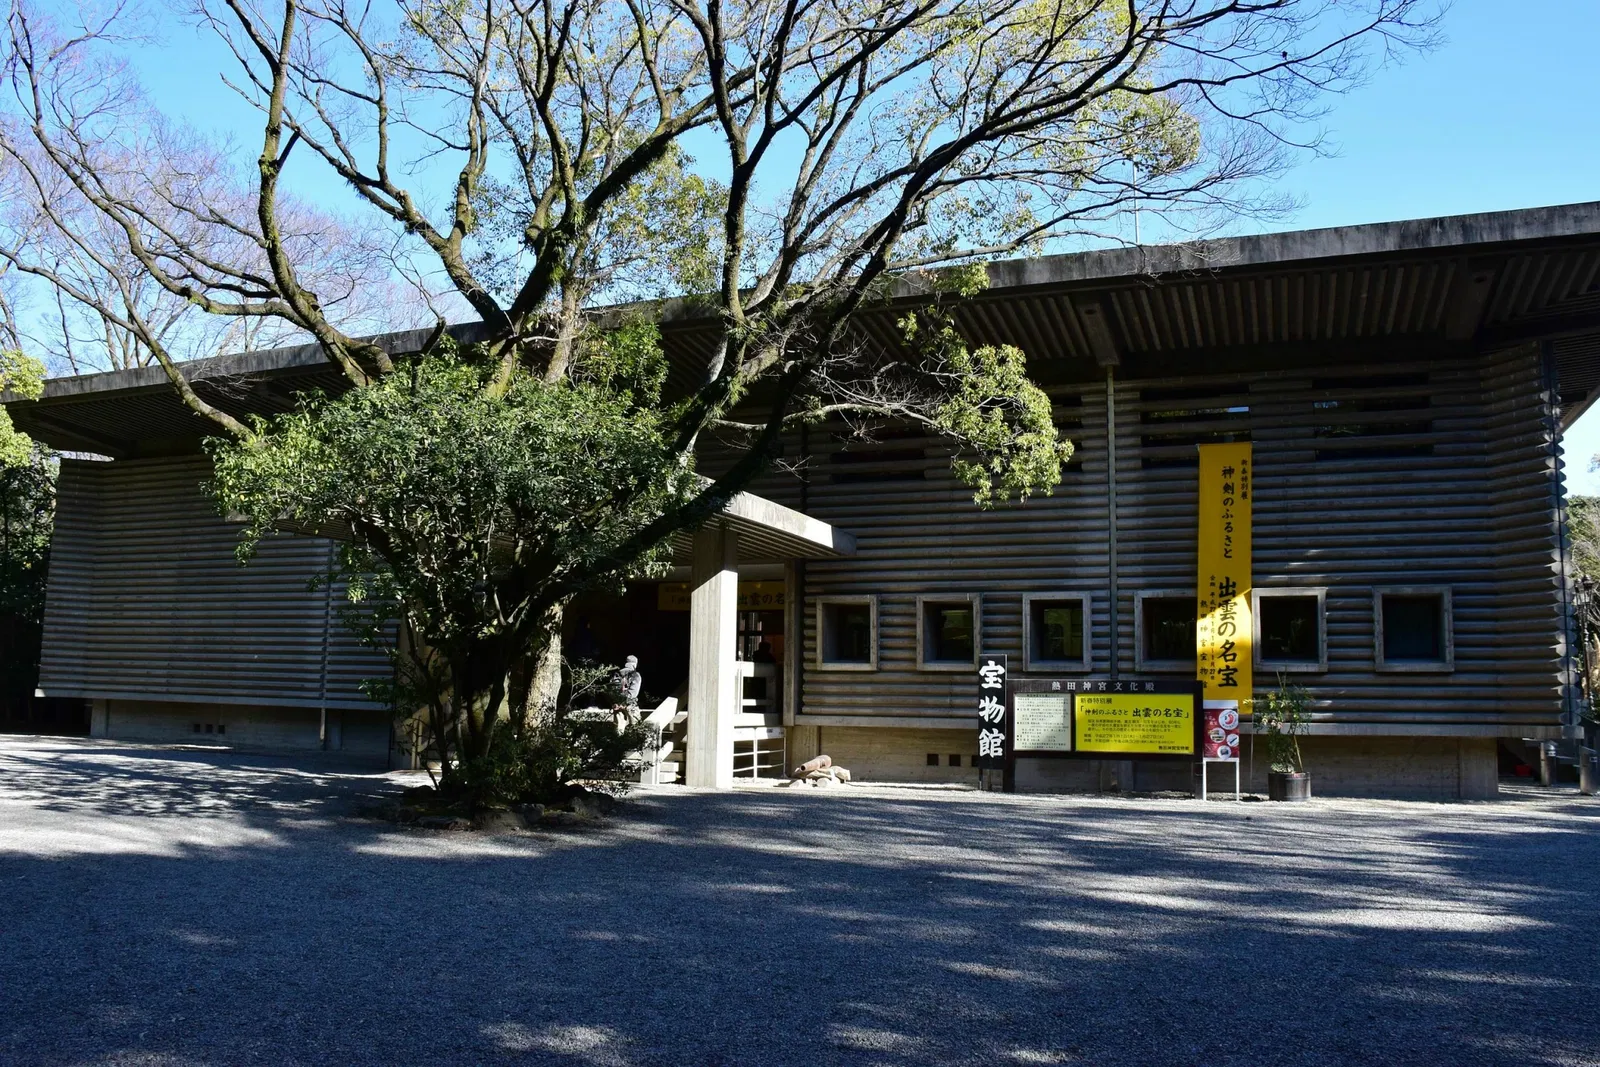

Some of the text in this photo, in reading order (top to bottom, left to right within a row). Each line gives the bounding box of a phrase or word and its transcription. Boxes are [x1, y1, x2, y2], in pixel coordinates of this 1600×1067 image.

[1217, 465, 1238, 688] 神剣のふるさと 出雲の名宝
[978, 660, 1006, 758] 宝物館
